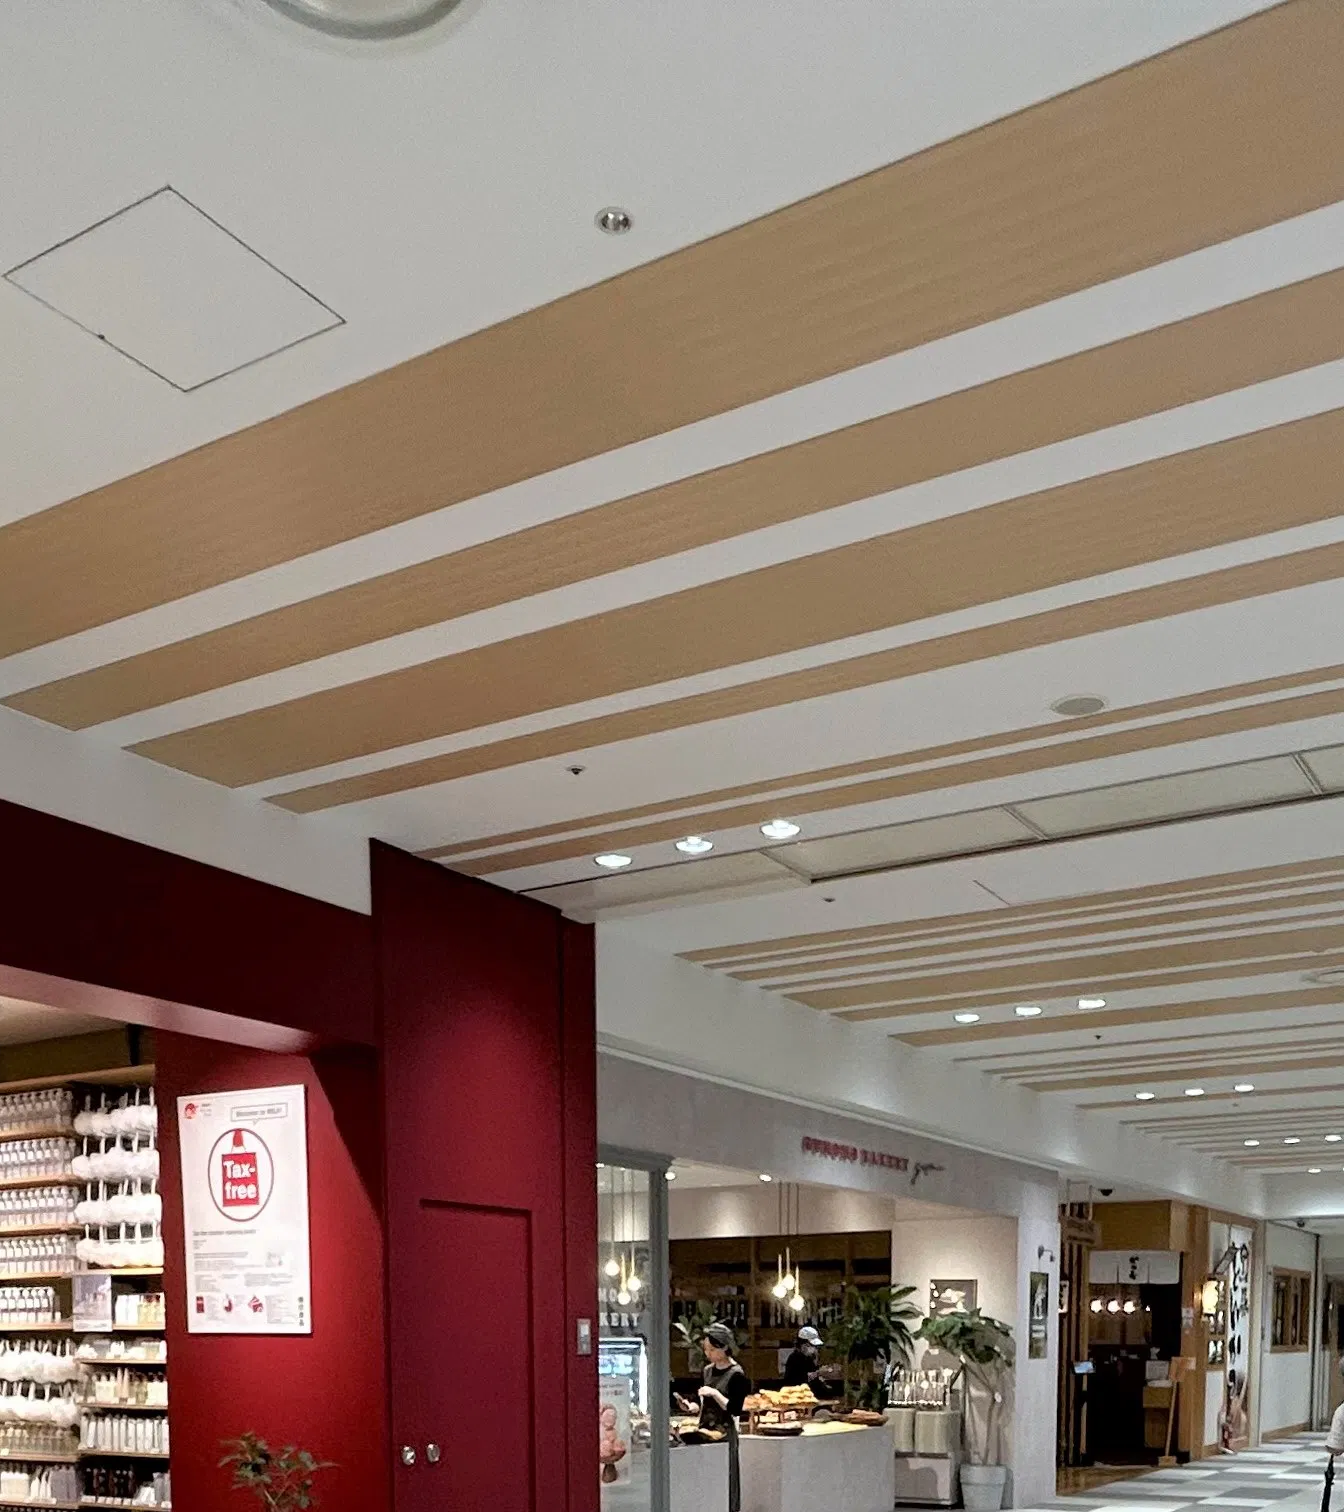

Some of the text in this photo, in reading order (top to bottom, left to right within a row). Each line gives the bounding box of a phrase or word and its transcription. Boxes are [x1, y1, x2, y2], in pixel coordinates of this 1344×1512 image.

[223, 1160, 256, 1179] Tax-
[225, 1181, 257, 1200] free
[599, 1311, 640, 1327] KERY
